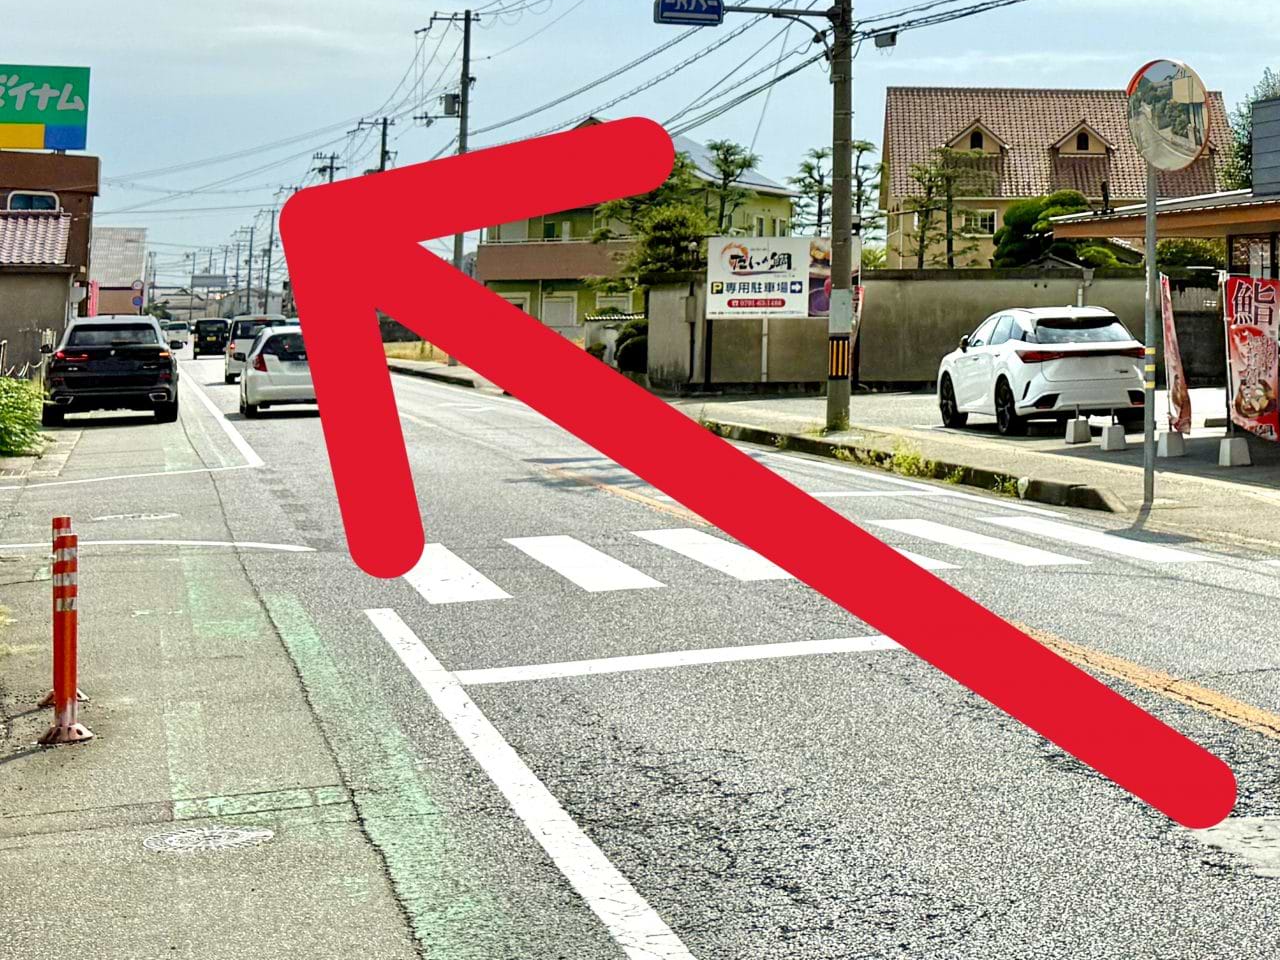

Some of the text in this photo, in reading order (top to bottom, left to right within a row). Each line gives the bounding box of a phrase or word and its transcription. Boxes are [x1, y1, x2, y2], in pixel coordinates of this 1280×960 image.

[726, 282, 788, 293] 専用駐車場
[1232, 279, 1276, 326] 鮨
